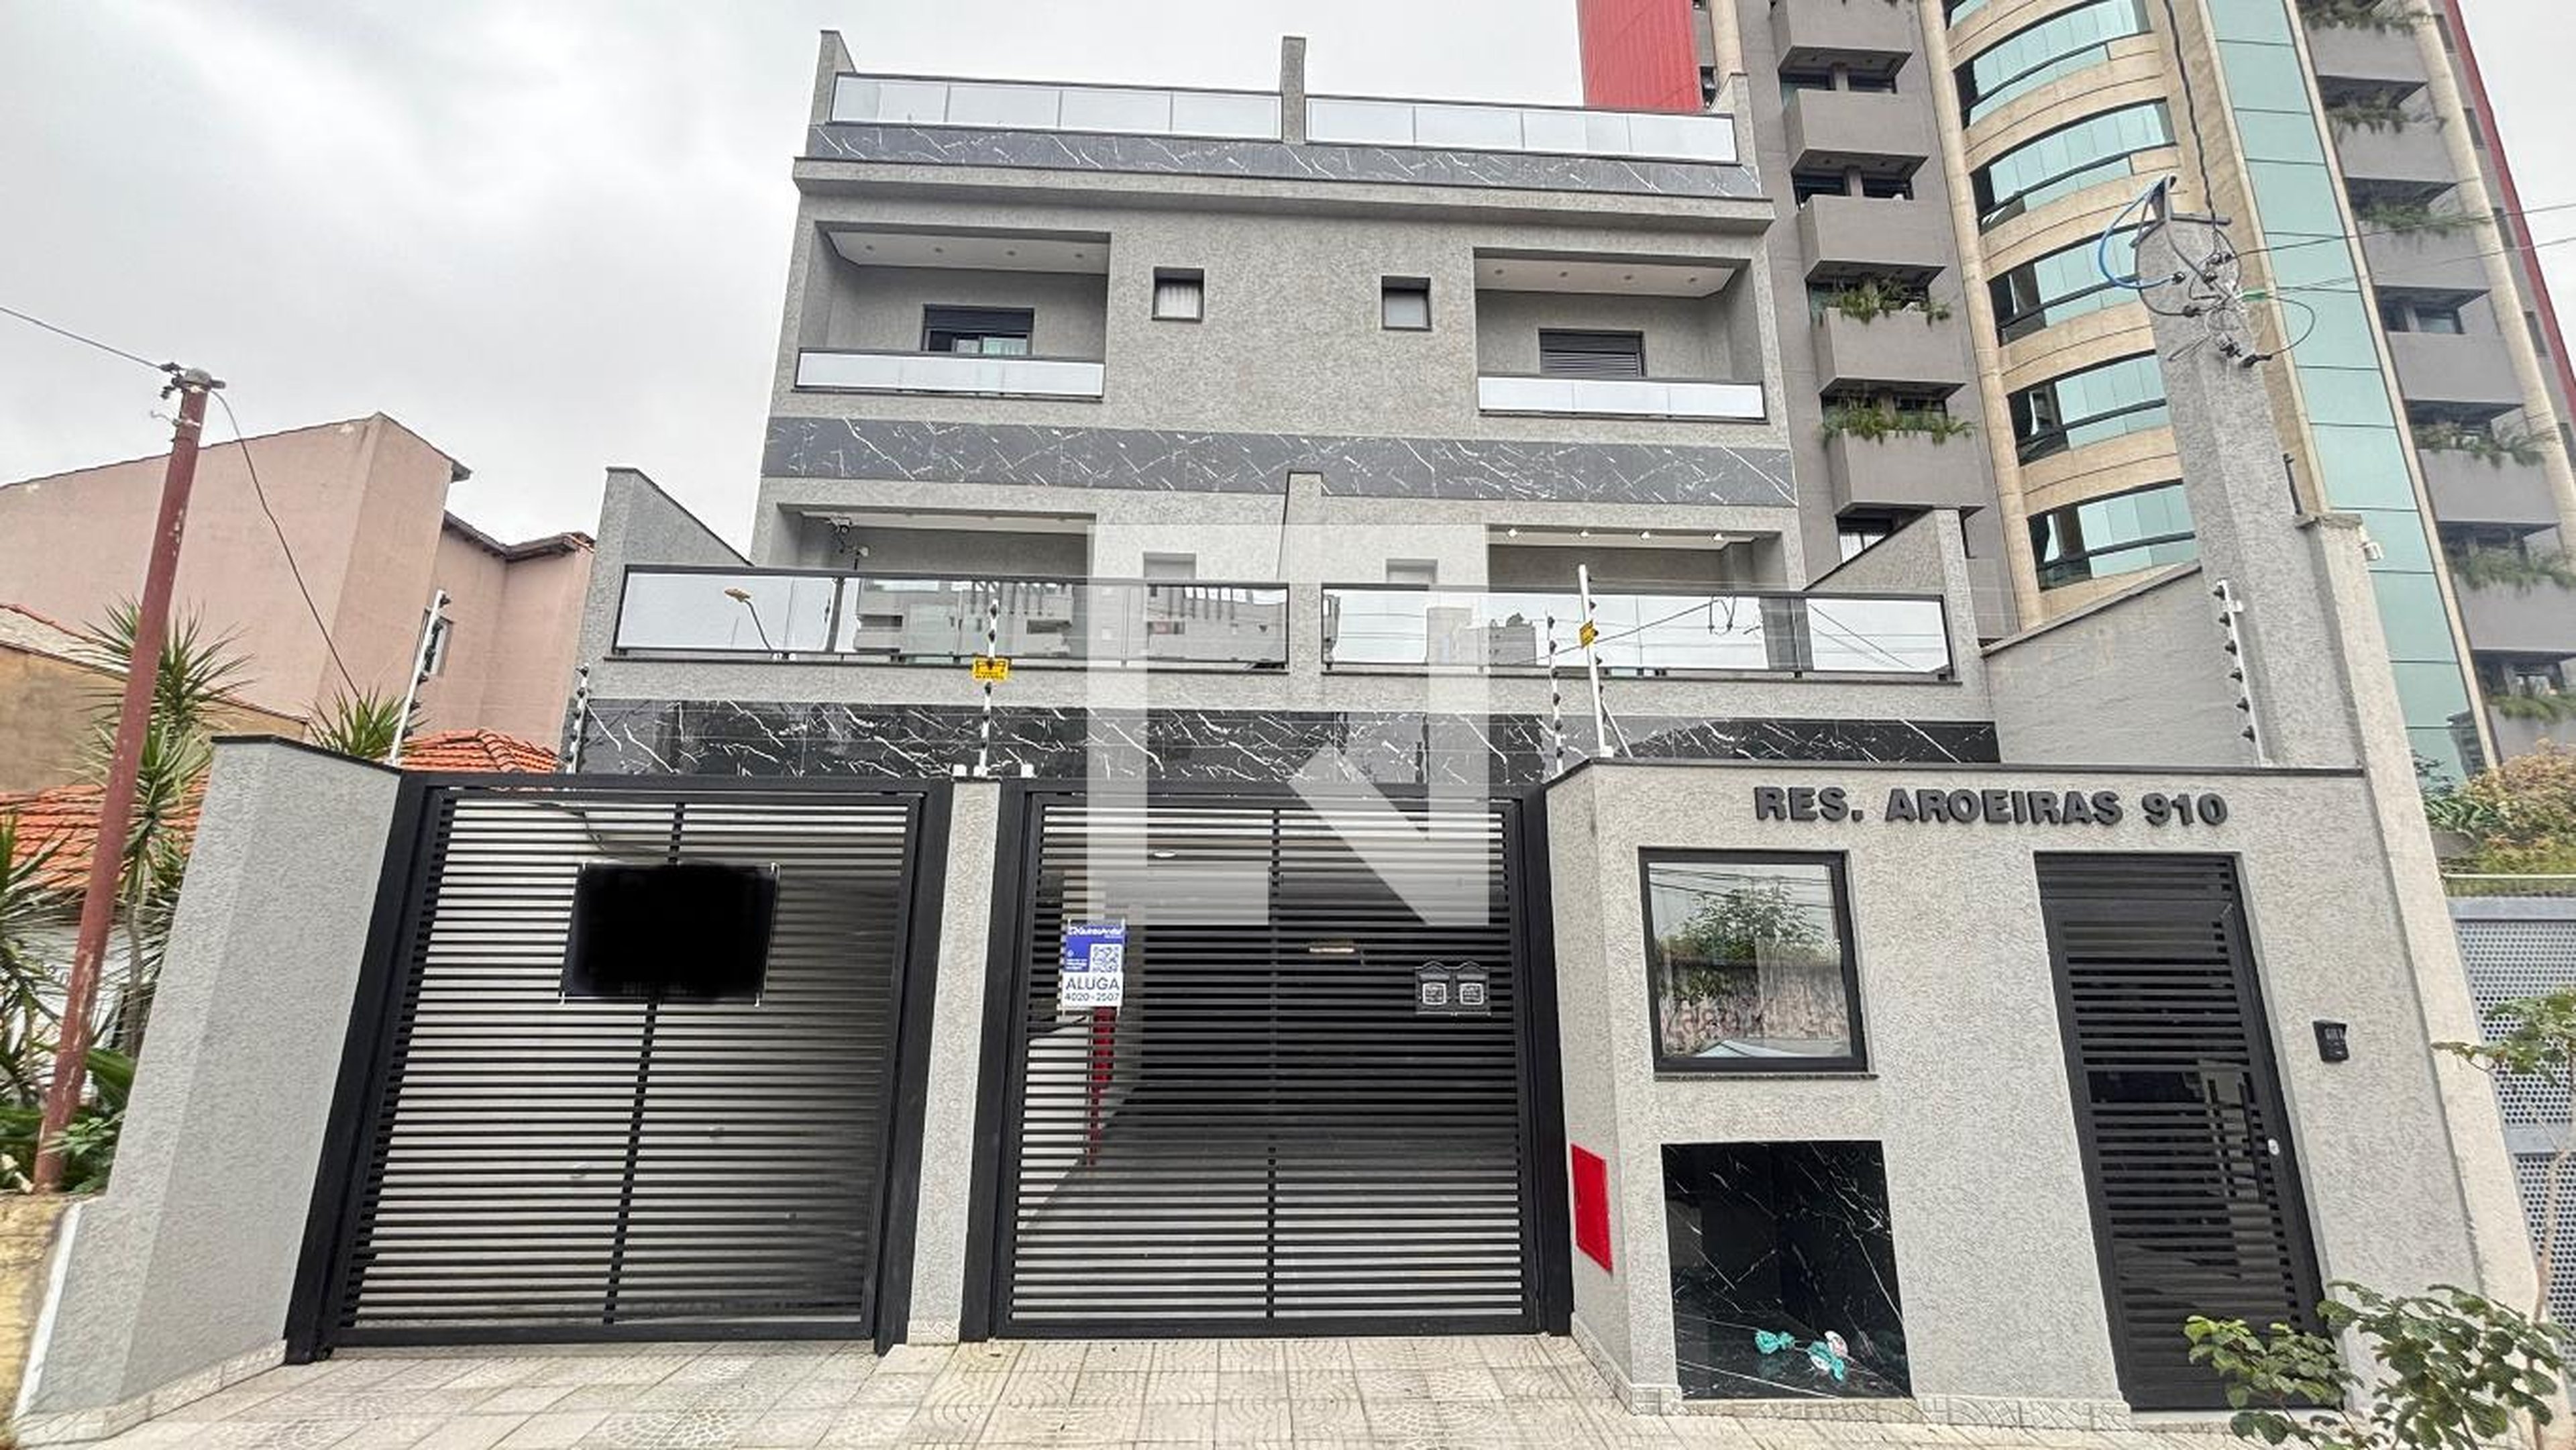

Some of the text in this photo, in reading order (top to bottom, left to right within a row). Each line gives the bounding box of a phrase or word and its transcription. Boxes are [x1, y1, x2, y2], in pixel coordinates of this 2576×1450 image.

[1754, 786, 2229, 827] RES. AROEIRAS 910
[1065, 977, 1120, 990] ALUGA
